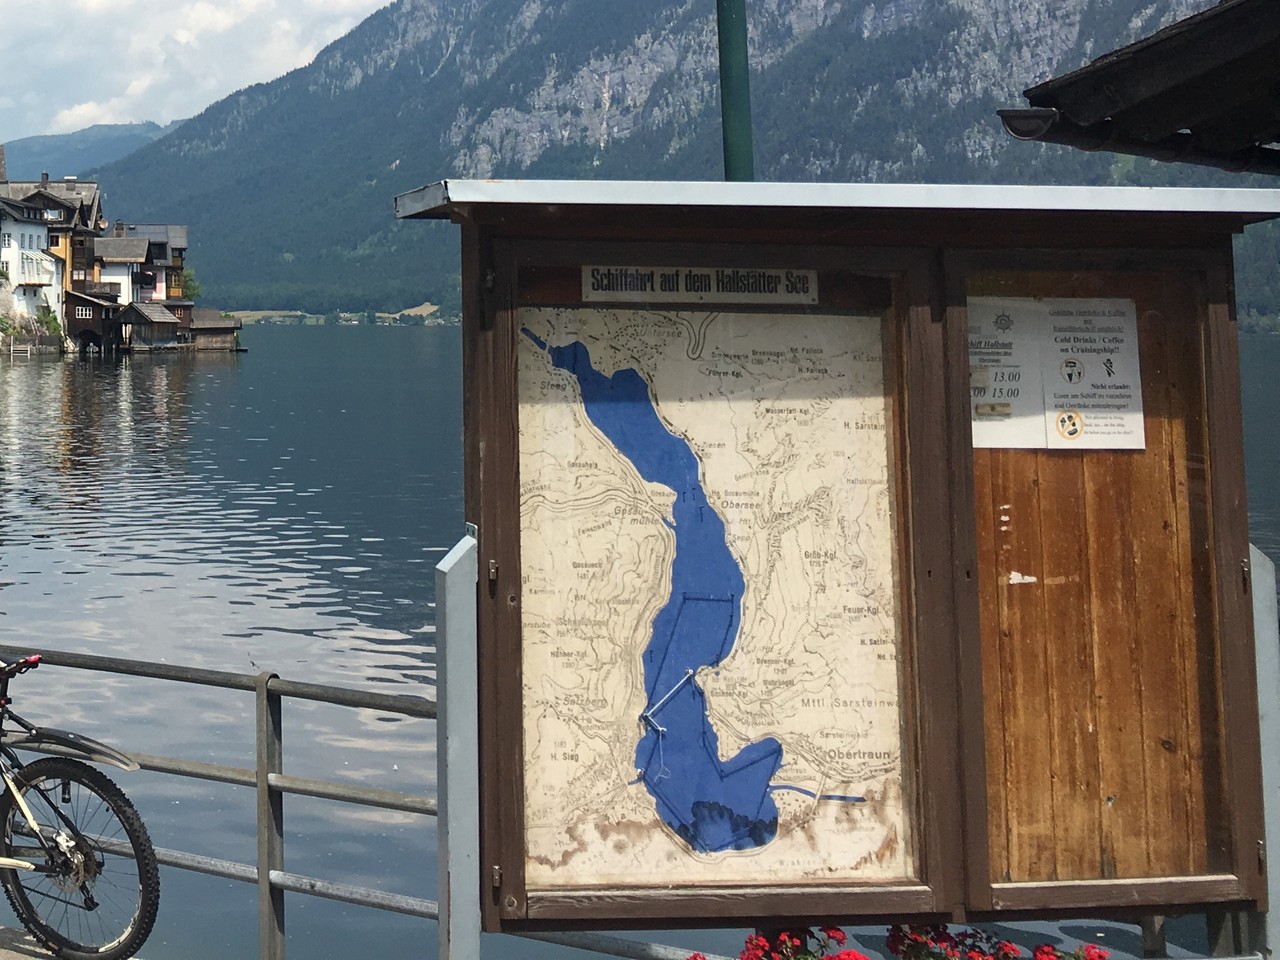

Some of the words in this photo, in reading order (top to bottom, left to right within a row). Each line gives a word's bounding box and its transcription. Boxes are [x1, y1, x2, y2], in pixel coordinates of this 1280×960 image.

[660, 270, 681, 292] auf
[685, 270, 711, 293] dem
[716, 270, 781, 294] Hallstätter
[785, 271, 810, 294] See
[1102, 336, 1125, 344] Coffee
[993, 371, 1021, 382] 13.00
[991, 387, 1020, 398] 15.00
[843, 421, 852, 430] H.
[721, 500, 761, 510] Obersee
[827, 748, 890, 760] Obertraun
